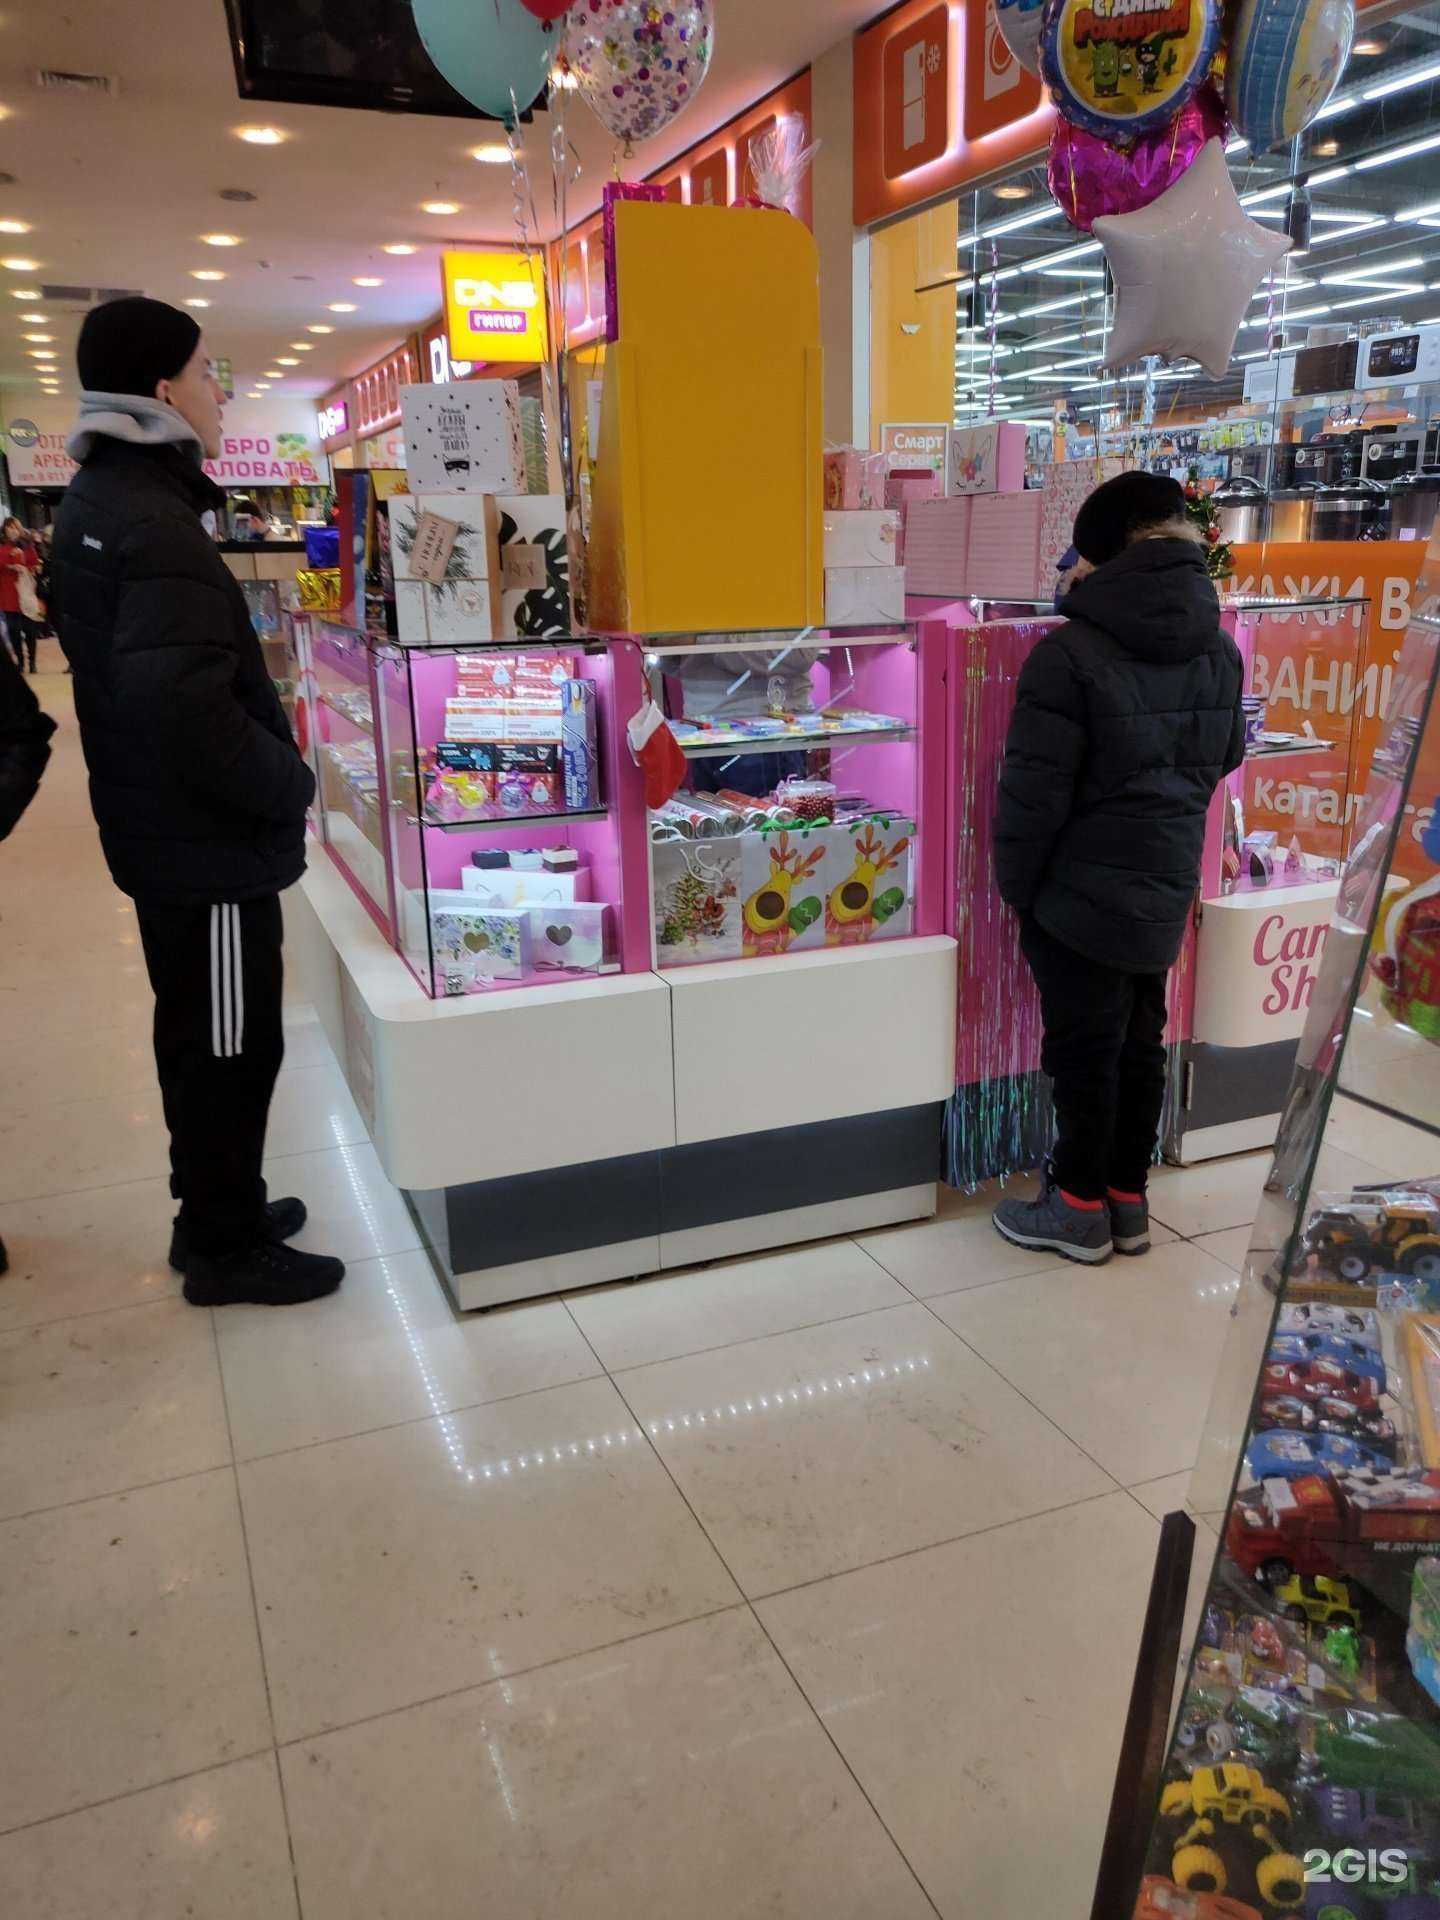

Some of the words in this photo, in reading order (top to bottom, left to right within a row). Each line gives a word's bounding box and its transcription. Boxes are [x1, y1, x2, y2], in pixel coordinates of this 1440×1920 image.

[454, 278, 538, 308] DNS
[223, 438, 271, 455] БРО
[893, 432, 944, 453] Смарт
[203, 460, 314, 479] АЛОВАТЬ
